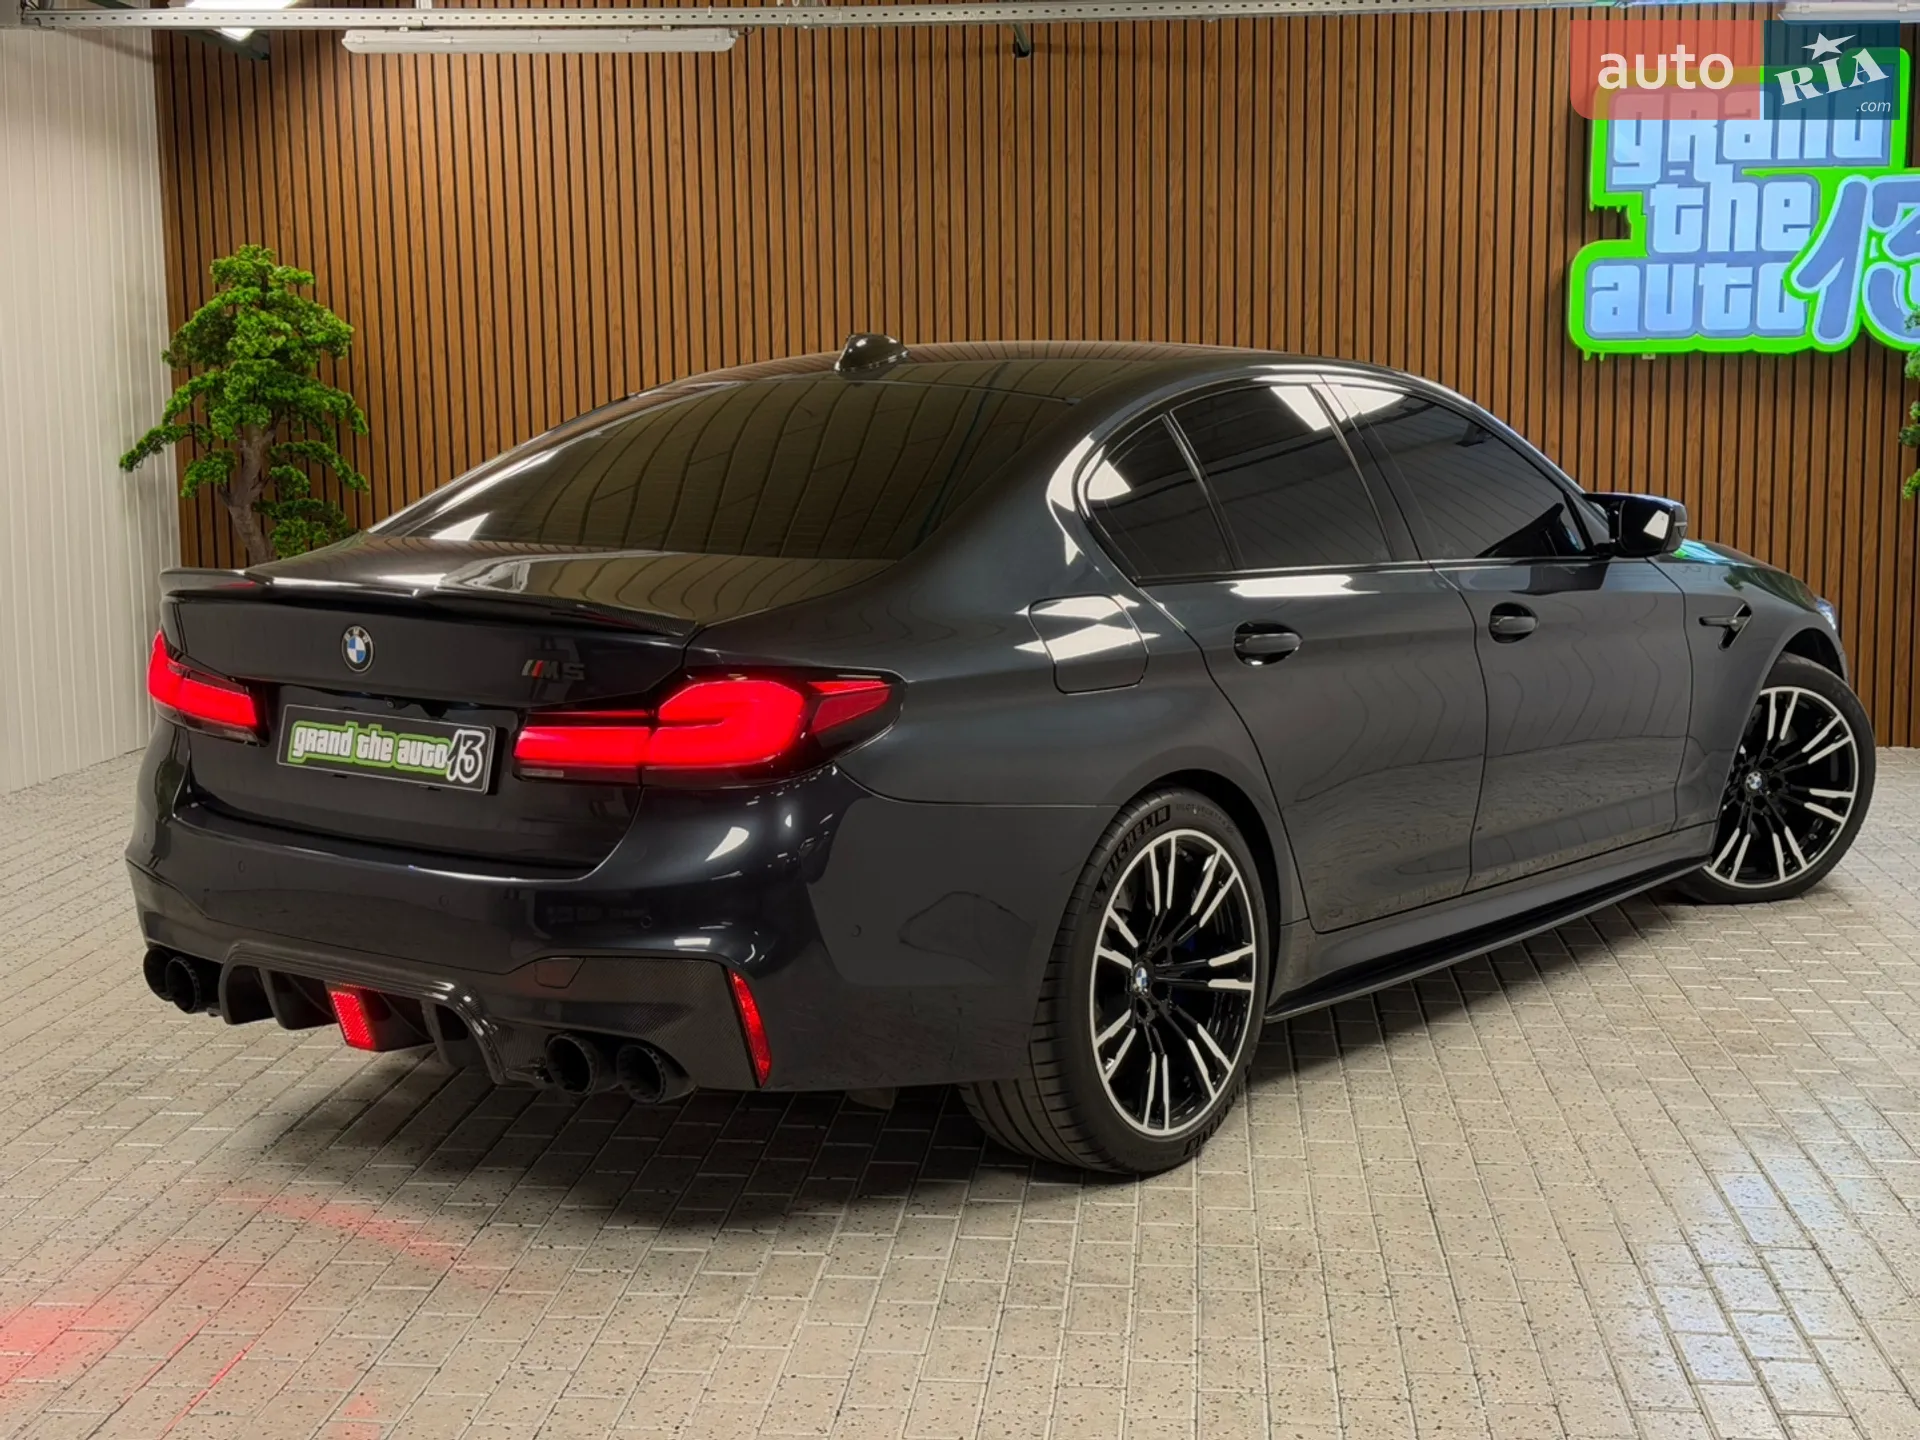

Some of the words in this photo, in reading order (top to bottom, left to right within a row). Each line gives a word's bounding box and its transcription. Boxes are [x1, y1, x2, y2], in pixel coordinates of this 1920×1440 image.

[1650, 166, 1813, 253] the
[1589, 262, 1806, 333] auto
[292, 726, 354, 757] grand
[356, 730, 394, 761] the
[396, 739, 450, 769] auto
[1102, 804, 1171, 887] MICHELIN
